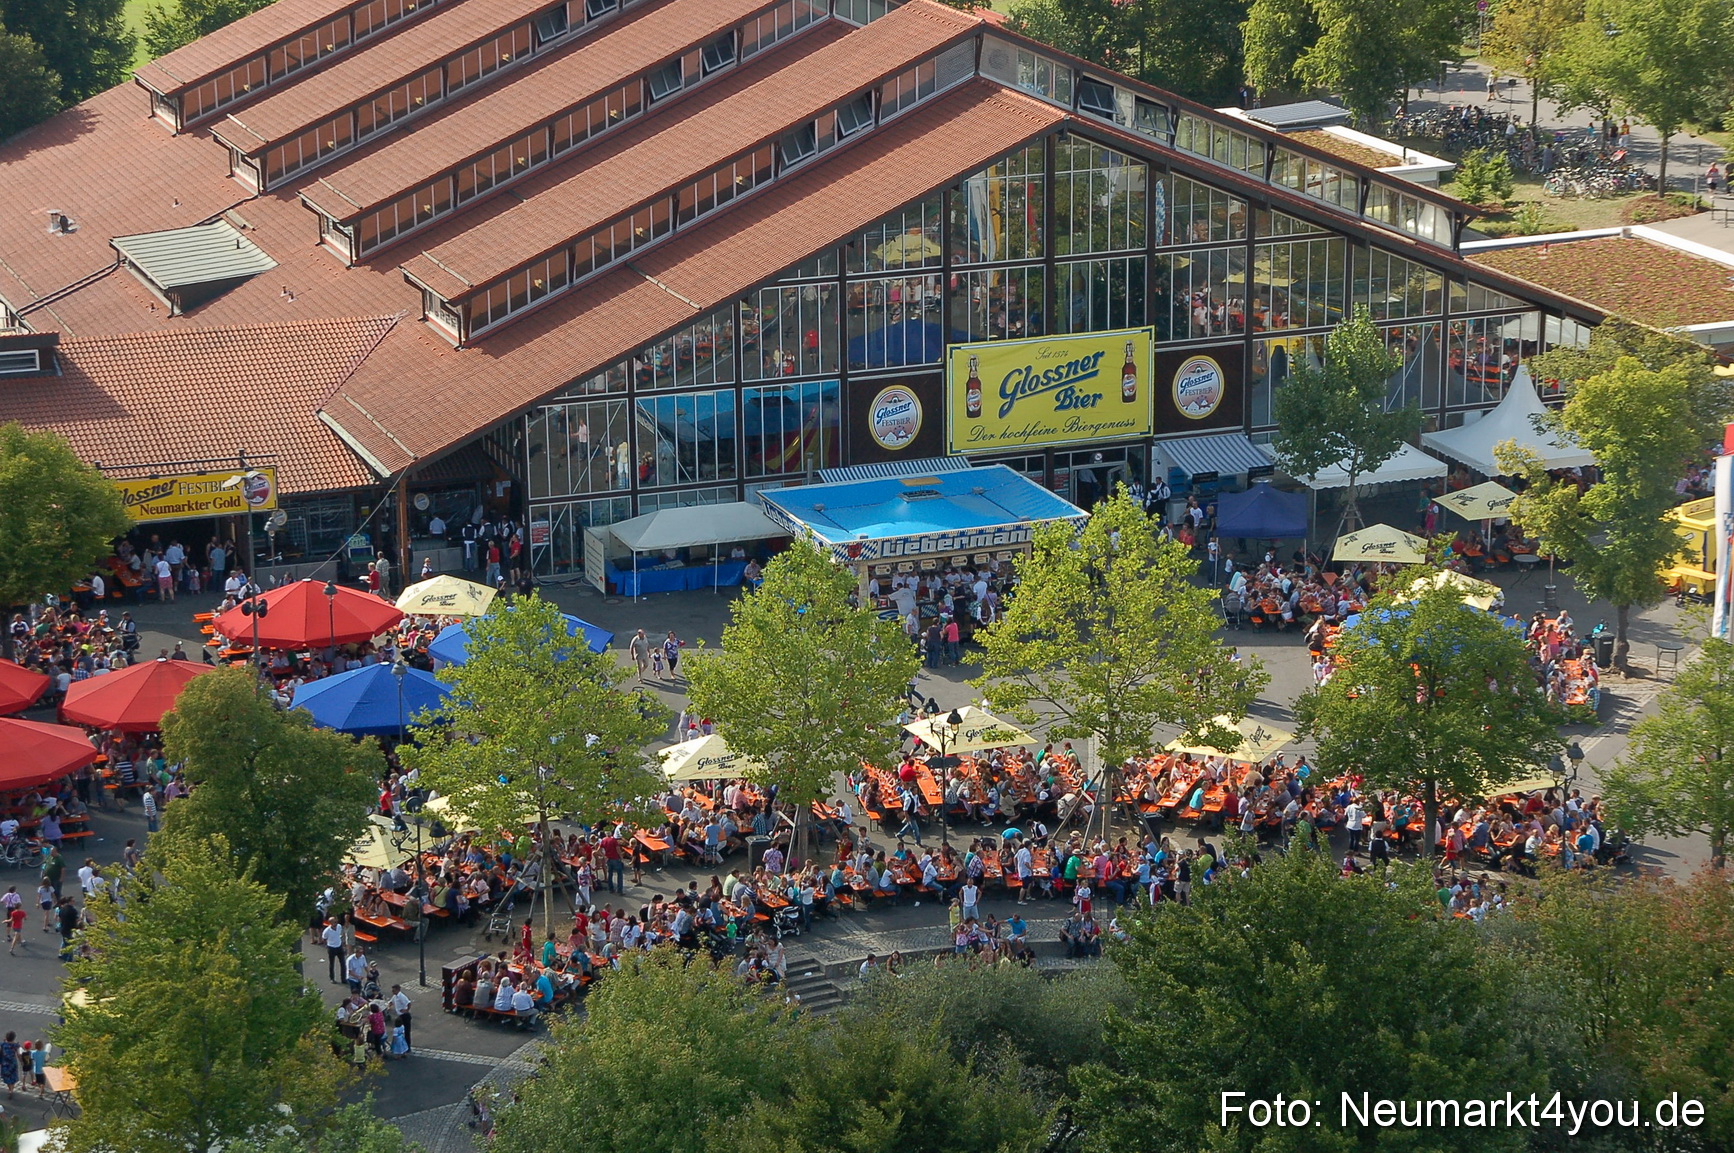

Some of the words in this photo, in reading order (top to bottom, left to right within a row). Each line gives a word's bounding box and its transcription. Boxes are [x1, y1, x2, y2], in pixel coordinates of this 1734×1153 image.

[999, 350, 1105, 419] Glossner
[1180, 372, 1214, 395] Glossner
[1054, 385, 1103, 411] Bier
[876, 402, 912, 425] Glossner
[882, 417, 910, 427] FESTBIER
[967, 424, 996, 442] Der
[999, 421, 1058, 443] hochfeine
[1062, 416, 1136, 436] Biergenuss
[120, 479, 178, 506] lossner
[140, 500, 211, 516] Neumarkter
[213, 496, 242, 509] Gold
[1361, 542, 1397, 554] Glossner
[421, 593, 458, 606] Glossner
[697, 754, 735, 770] Glossner
